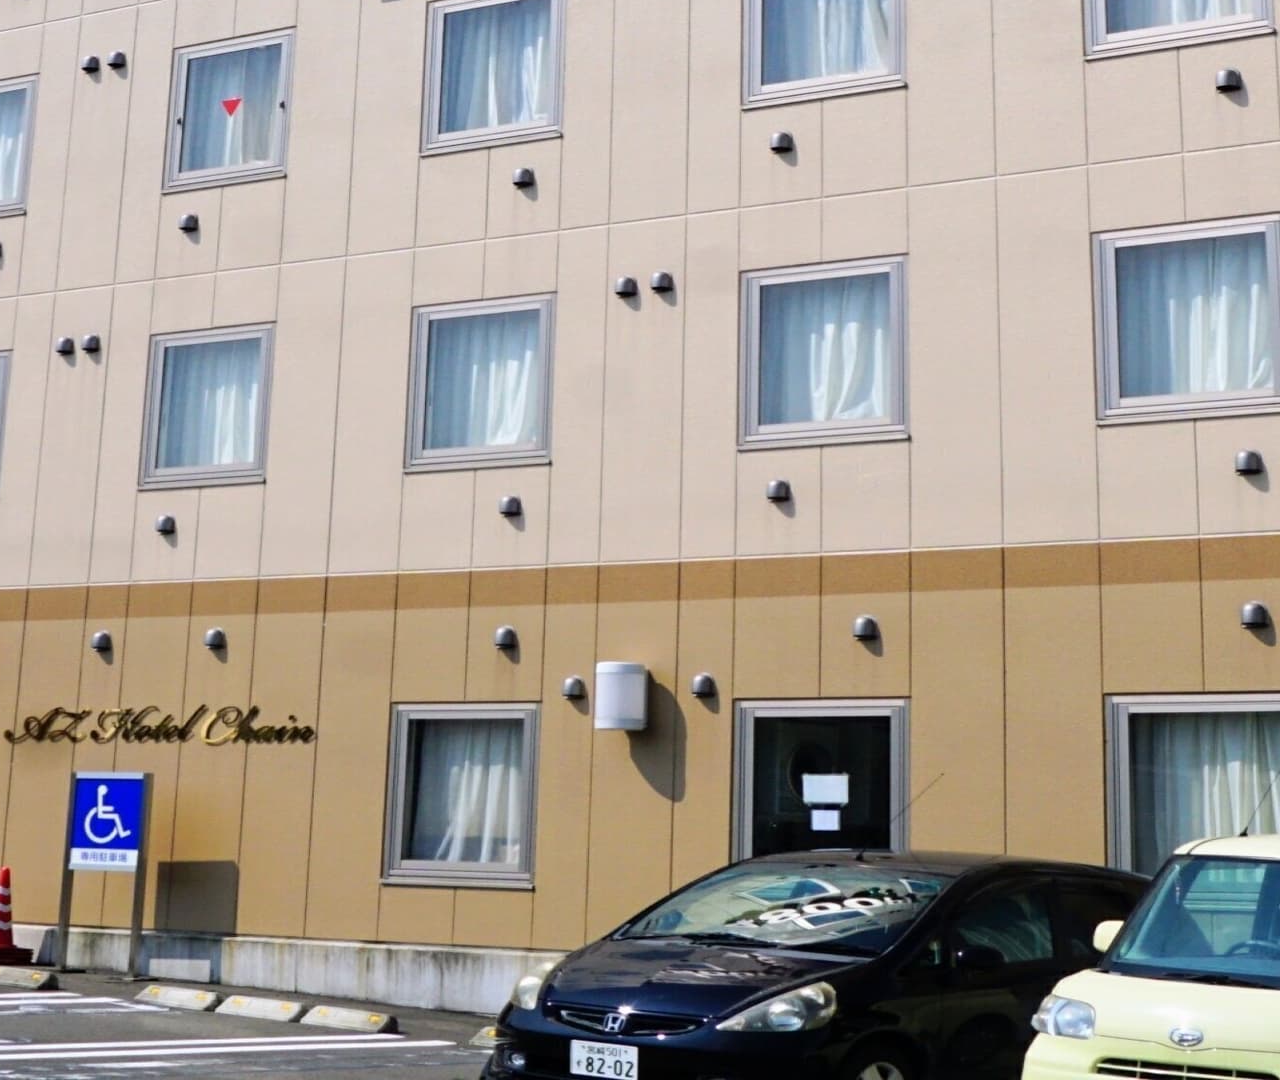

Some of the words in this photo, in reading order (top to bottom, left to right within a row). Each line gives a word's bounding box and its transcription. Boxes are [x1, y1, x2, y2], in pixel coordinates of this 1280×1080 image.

[4, 706, 92, 744] AZ
[90, 703, 208, 744] Hotel
[201, 704, 318, 747] Chain
[585, 1056, 634, 1077] 82-02
